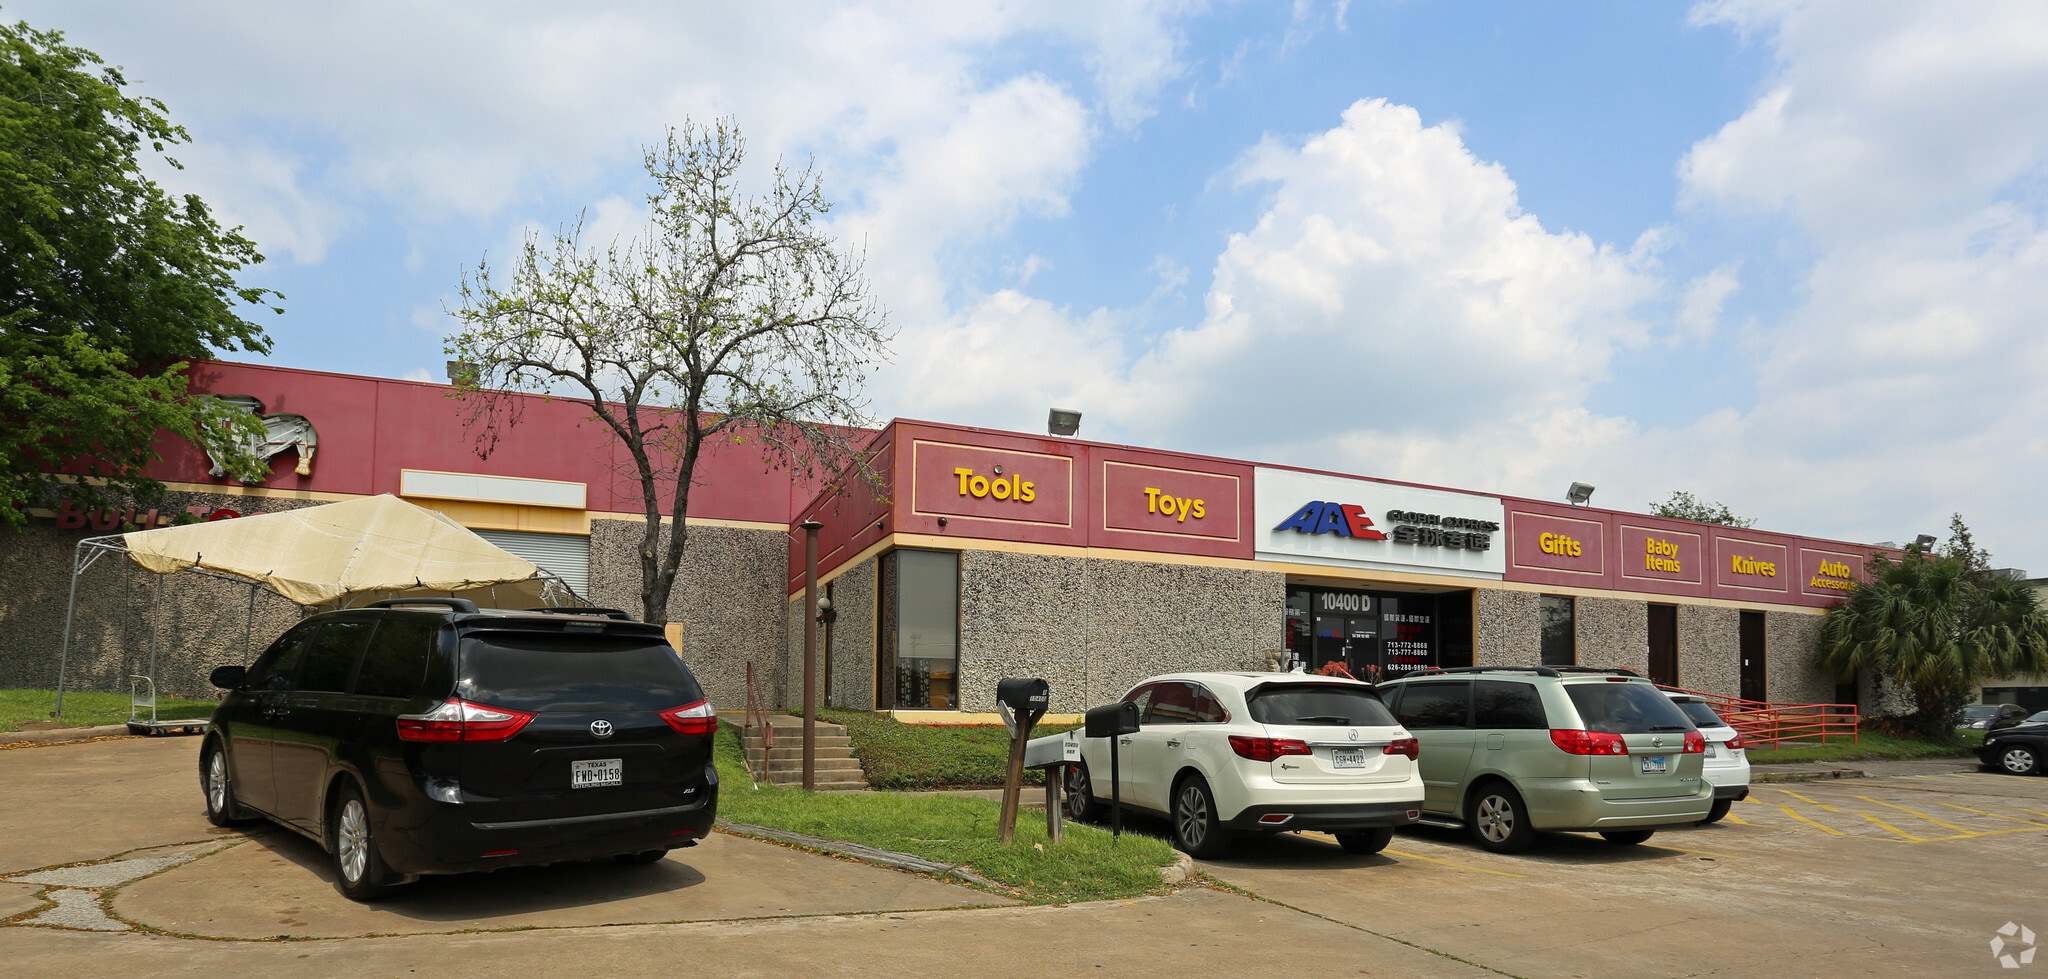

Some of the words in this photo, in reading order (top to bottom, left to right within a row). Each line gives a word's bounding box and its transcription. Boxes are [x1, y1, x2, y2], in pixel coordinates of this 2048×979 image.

[953, 467, 1036, 503] Tools
[1143, 487, 1206, 523] Toys
[1272, 500, 1387, 541] AAE
[1386, 509, 1442, 526] GLOBAL
[1392, 525, 1490, 552] 全球专递
[1538, 532, 1582, 558] Gifts
[1646, 537, 1679, 560] Baby
[1645, 554, 1681, 574] Items
[1731, 555, 1776, 578] Knives
[1817, 558, 1851, 579] Auto
[1321, 592, 1359, 611] 10400
[1361, 595, 1371, 612] D
